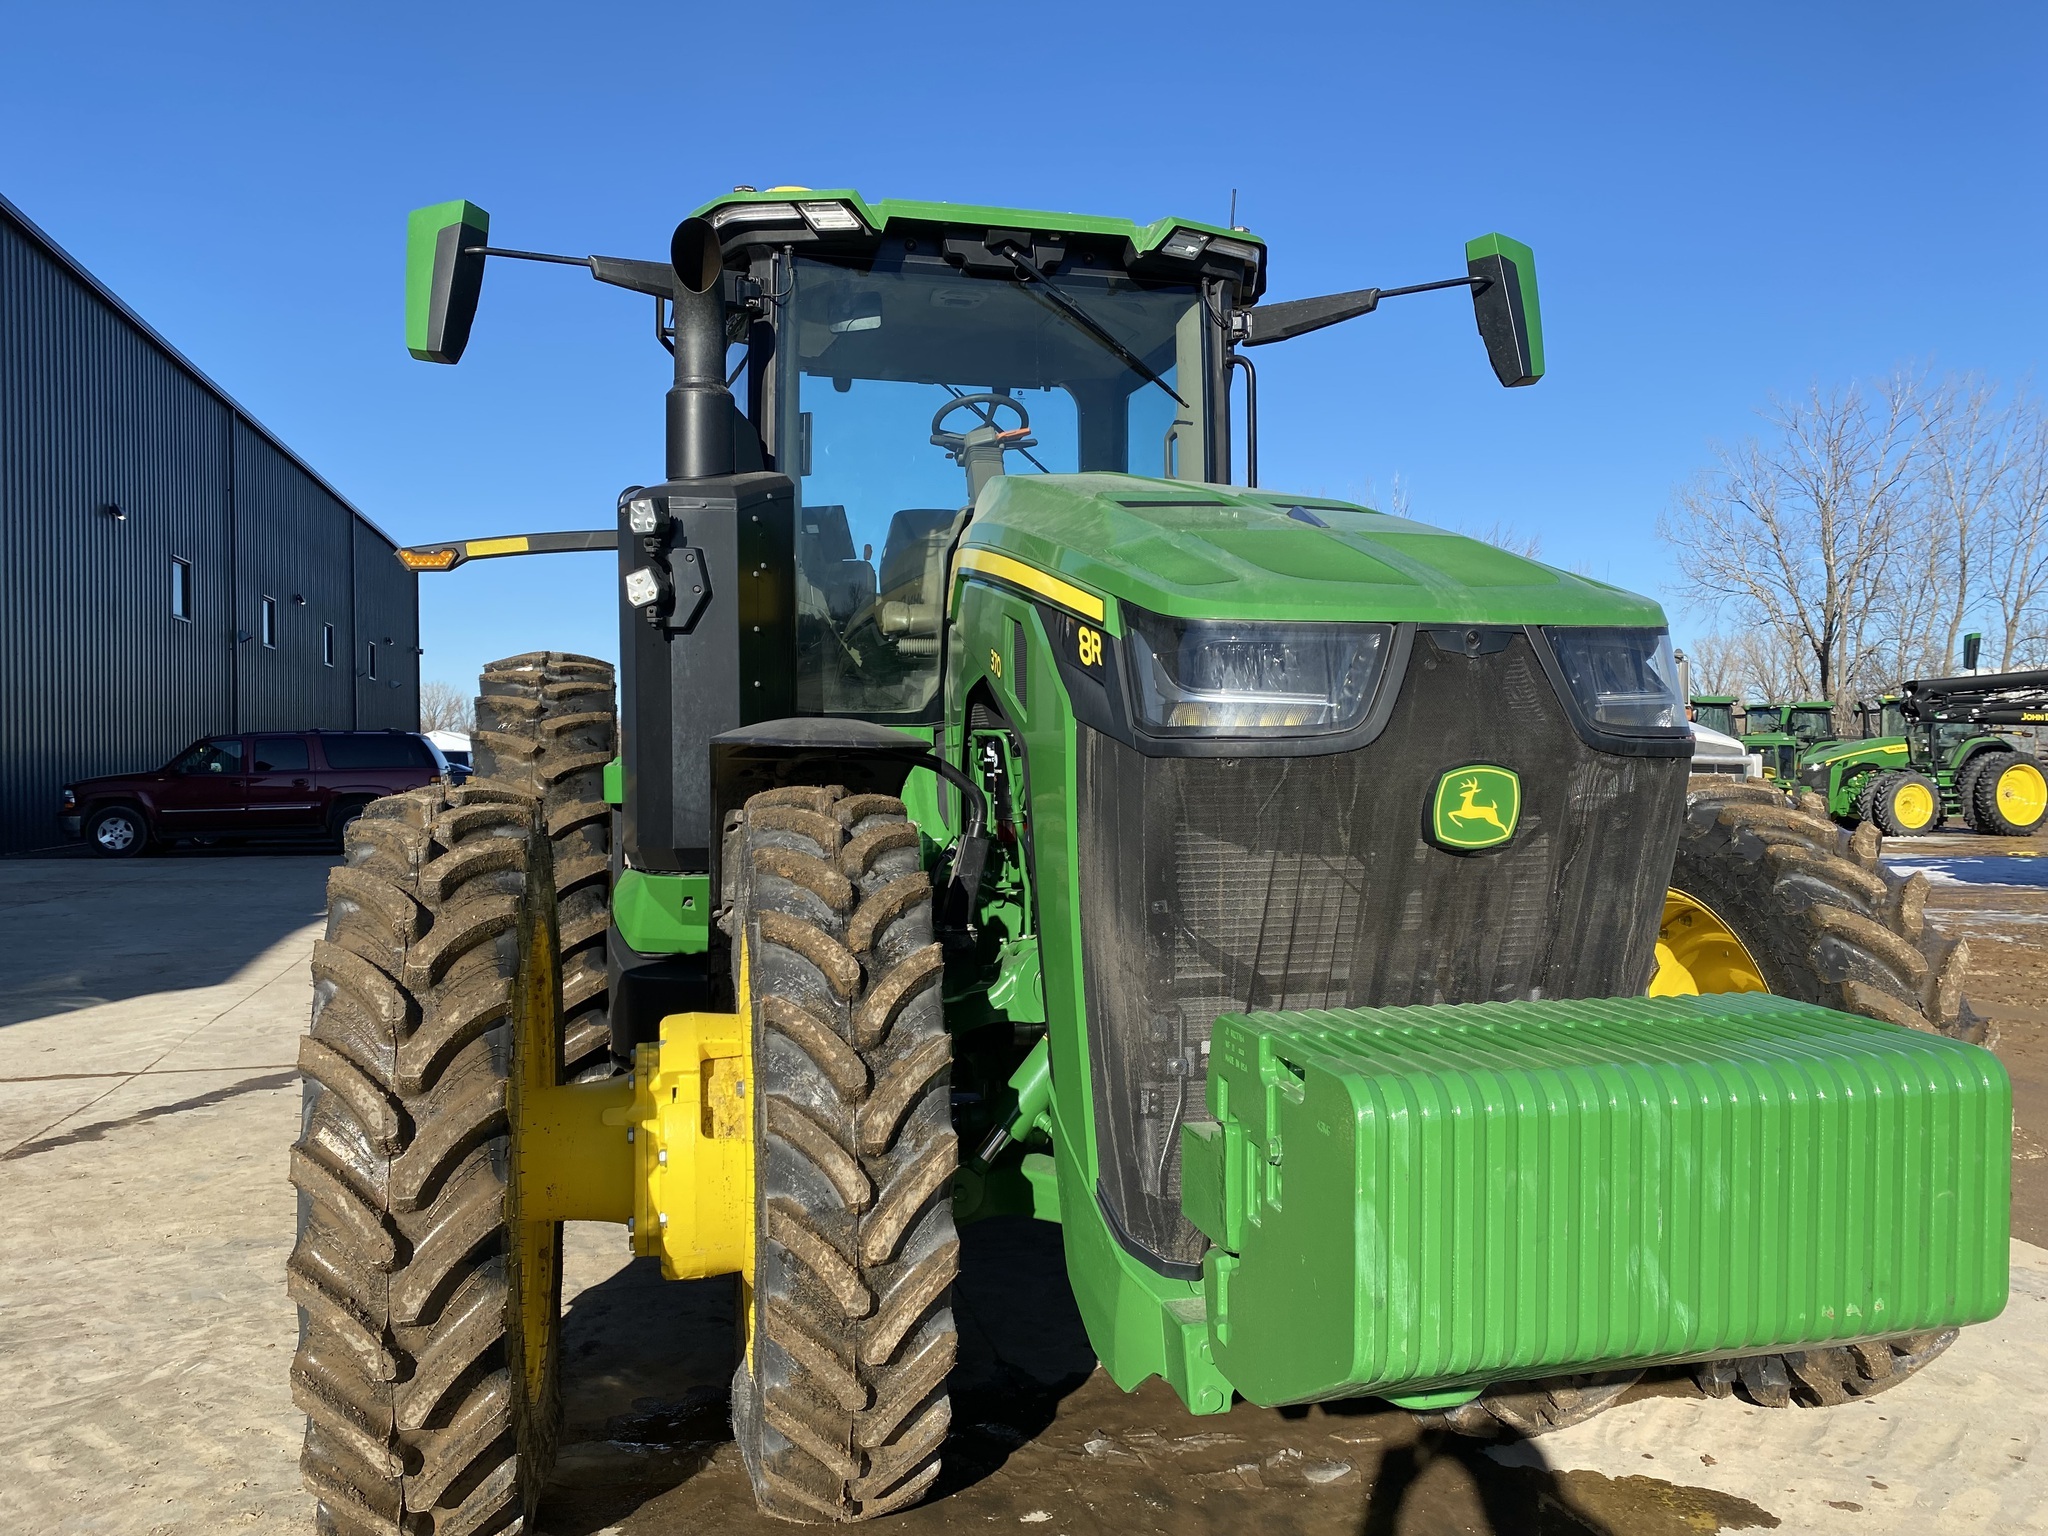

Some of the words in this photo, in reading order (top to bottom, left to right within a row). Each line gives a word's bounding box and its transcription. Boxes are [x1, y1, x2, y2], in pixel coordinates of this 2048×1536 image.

[1078, 626, 1102, 667] 8R
[990, 648, 1002, 679] 370
[2021, 712, 2044, 721] JOHN
